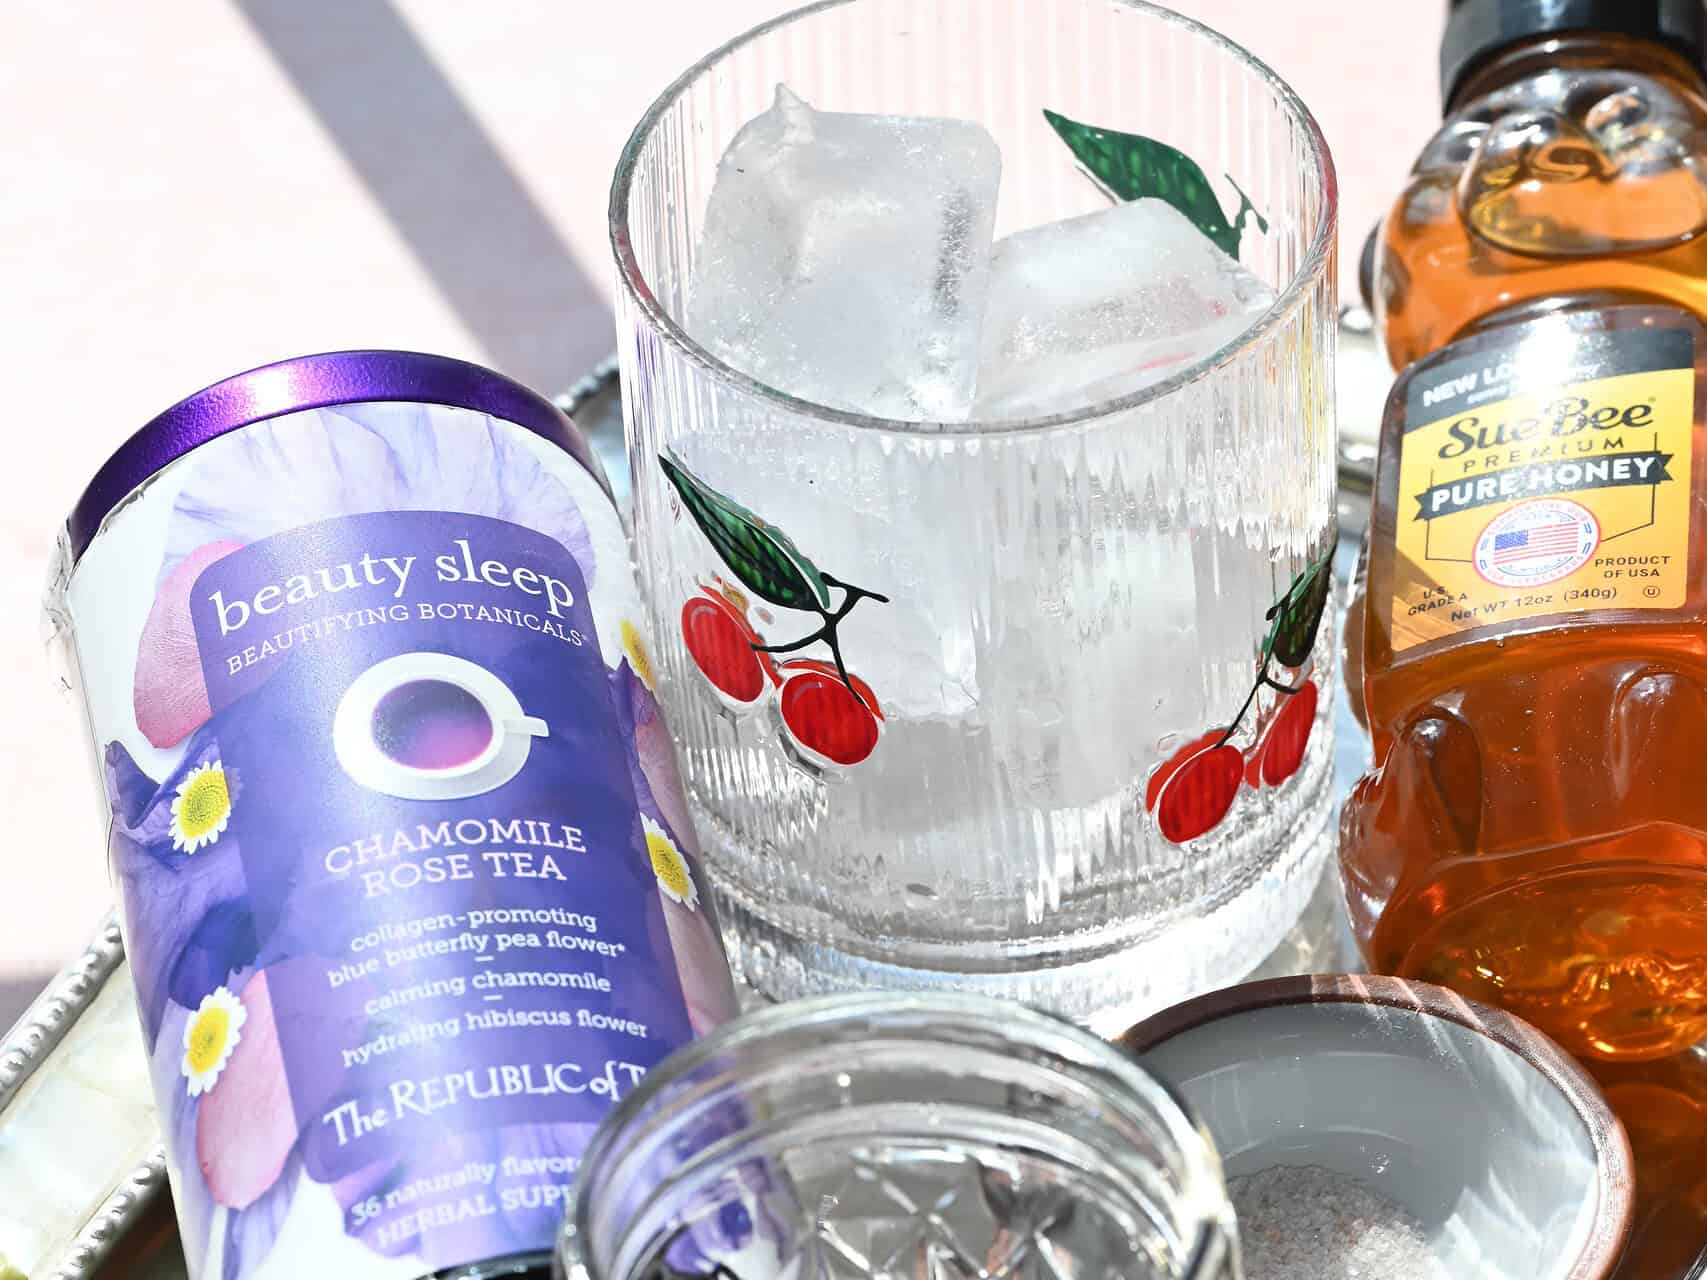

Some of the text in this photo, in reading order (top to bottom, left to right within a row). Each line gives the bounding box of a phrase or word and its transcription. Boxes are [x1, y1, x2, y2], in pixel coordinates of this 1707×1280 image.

[1423, 374, 1477, 407] NEW
[1438, 415, 1539, 459] Sue
[1462, 436, 1625, 473] PREMIUM
[1431, 456, 1656, 512] PURE HONEY
[1595, 556, 1671, 568] PRODUCT
[1604, 568, 1660, 579] OF USA
[208, 540, 575, 638] beauty sleep
[1407, 594, 1454, 617] GRADE
[1563, 587, 1617, 601] (340g)
[226, 603, 584, 676] BEAUTIFYING BOTANICALS
[324, 818, 587, 874] CHAMOMILE
[361, 852, 568, 899] ROSE TEA
[350, 907, 598, 952] collagen-promoting
[327, 960, 380, 988] blue
[386, 932, 490, 967] butterfly
[496, 935, 541, 953] pea
[365, 970, 612, 1014] calming chamomile
[342, 1008, 648, 1069] hydrating hibiscus flower
[323, 1100, 390, 1146] The
[389, 1063, 586, 1120] REPUBLIC
[589, 1061, 621, 1102] of
[351, 1156, 582, 1227] 36 naturally flavor
[376, 1193, 497, 1250] HERBAL
